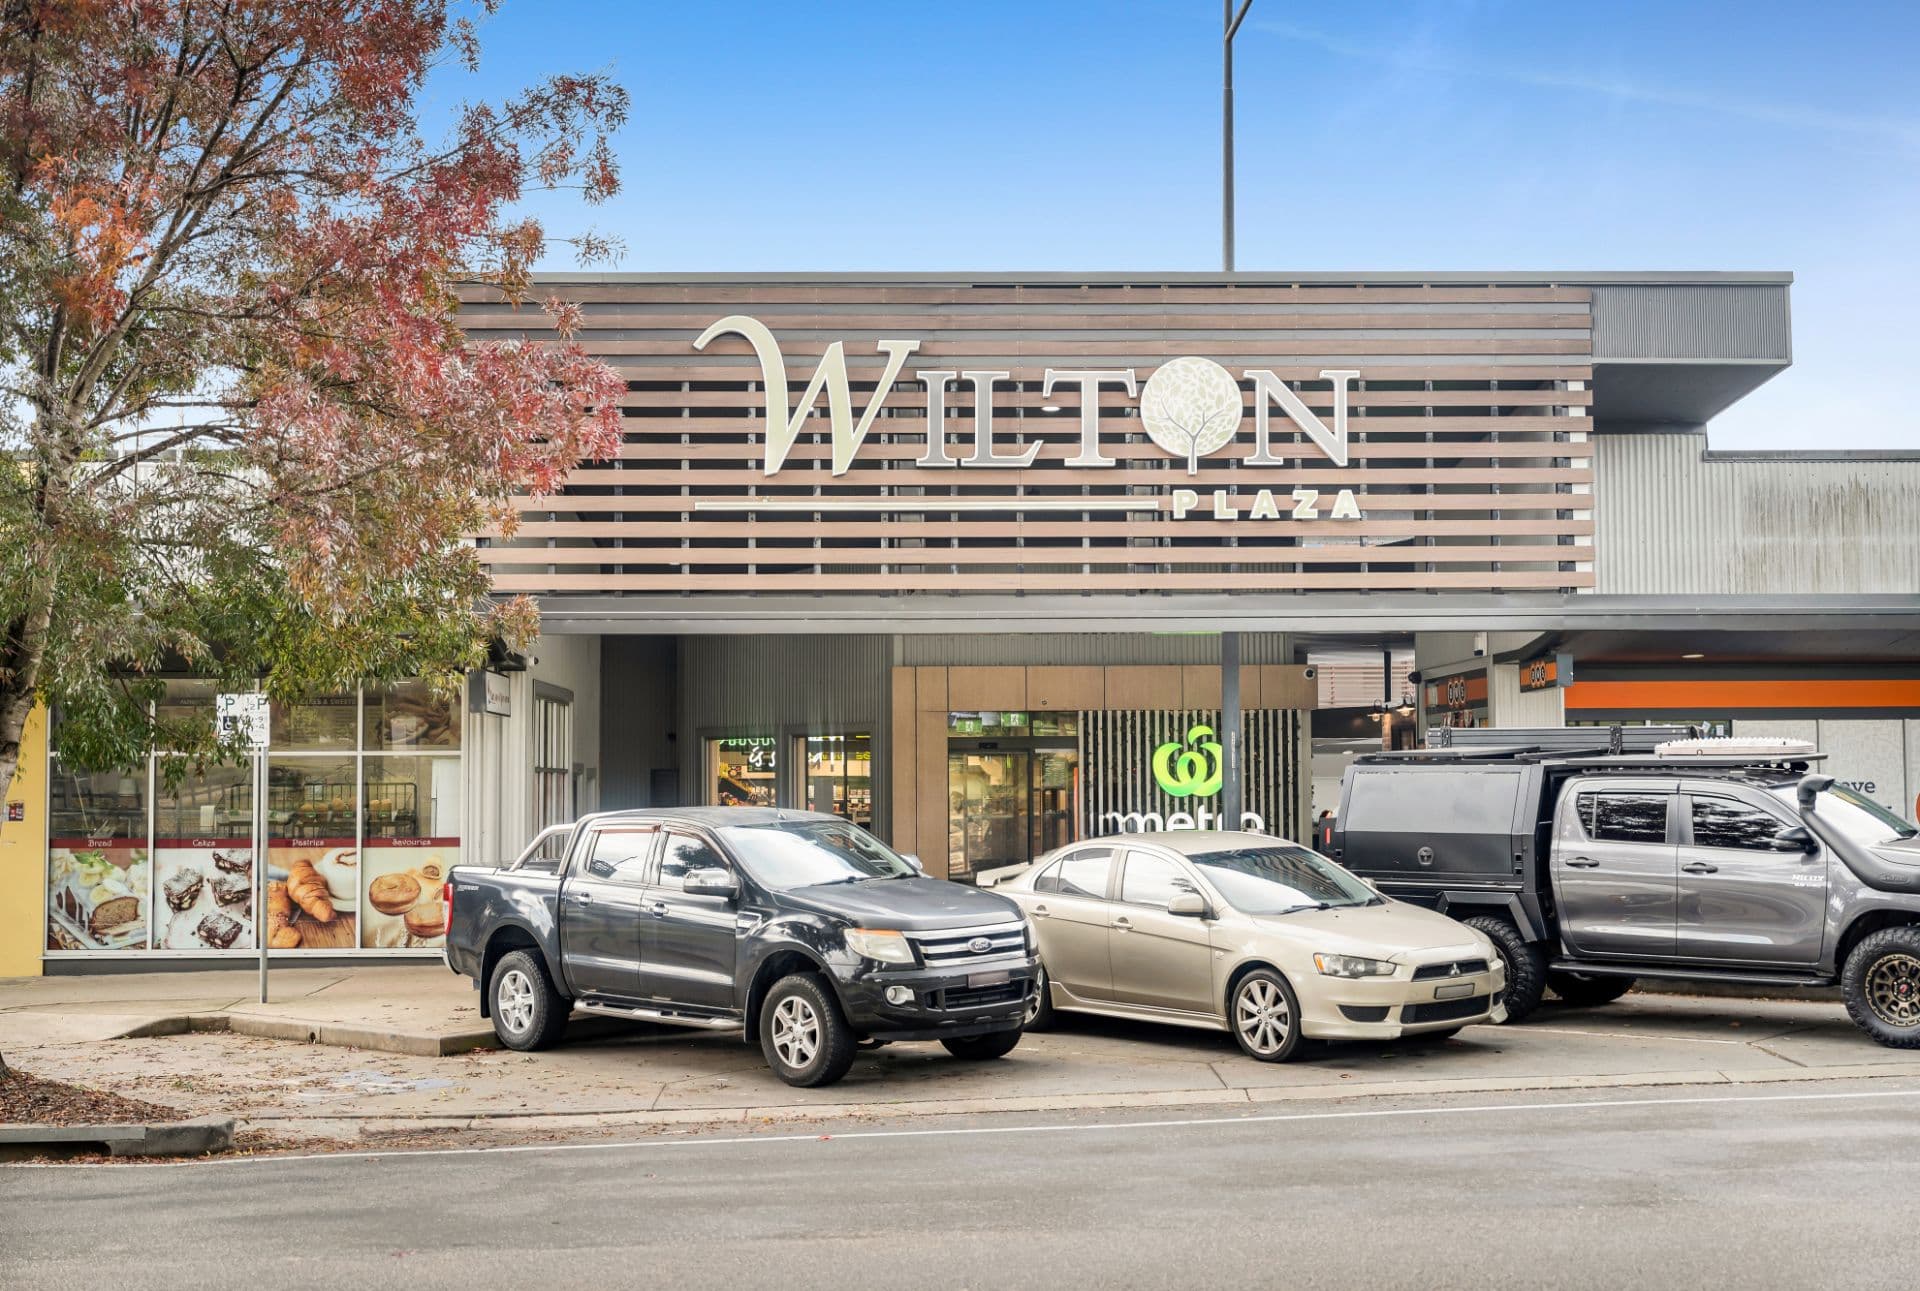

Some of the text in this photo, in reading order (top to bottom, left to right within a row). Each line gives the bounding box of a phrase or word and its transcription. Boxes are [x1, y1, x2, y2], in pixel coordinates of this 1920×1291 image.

[693, 315, 1362, 477] WILTON
[1172, 489, 1362, 520] PLAZA
[225, 697, 235, 710] P
[87, 839, 112, 848] Bread
[192, 839, 216, 848] Cakes
[292, 838, 325, 848] Pastries
[391, 838, 432, 846] Savouries
